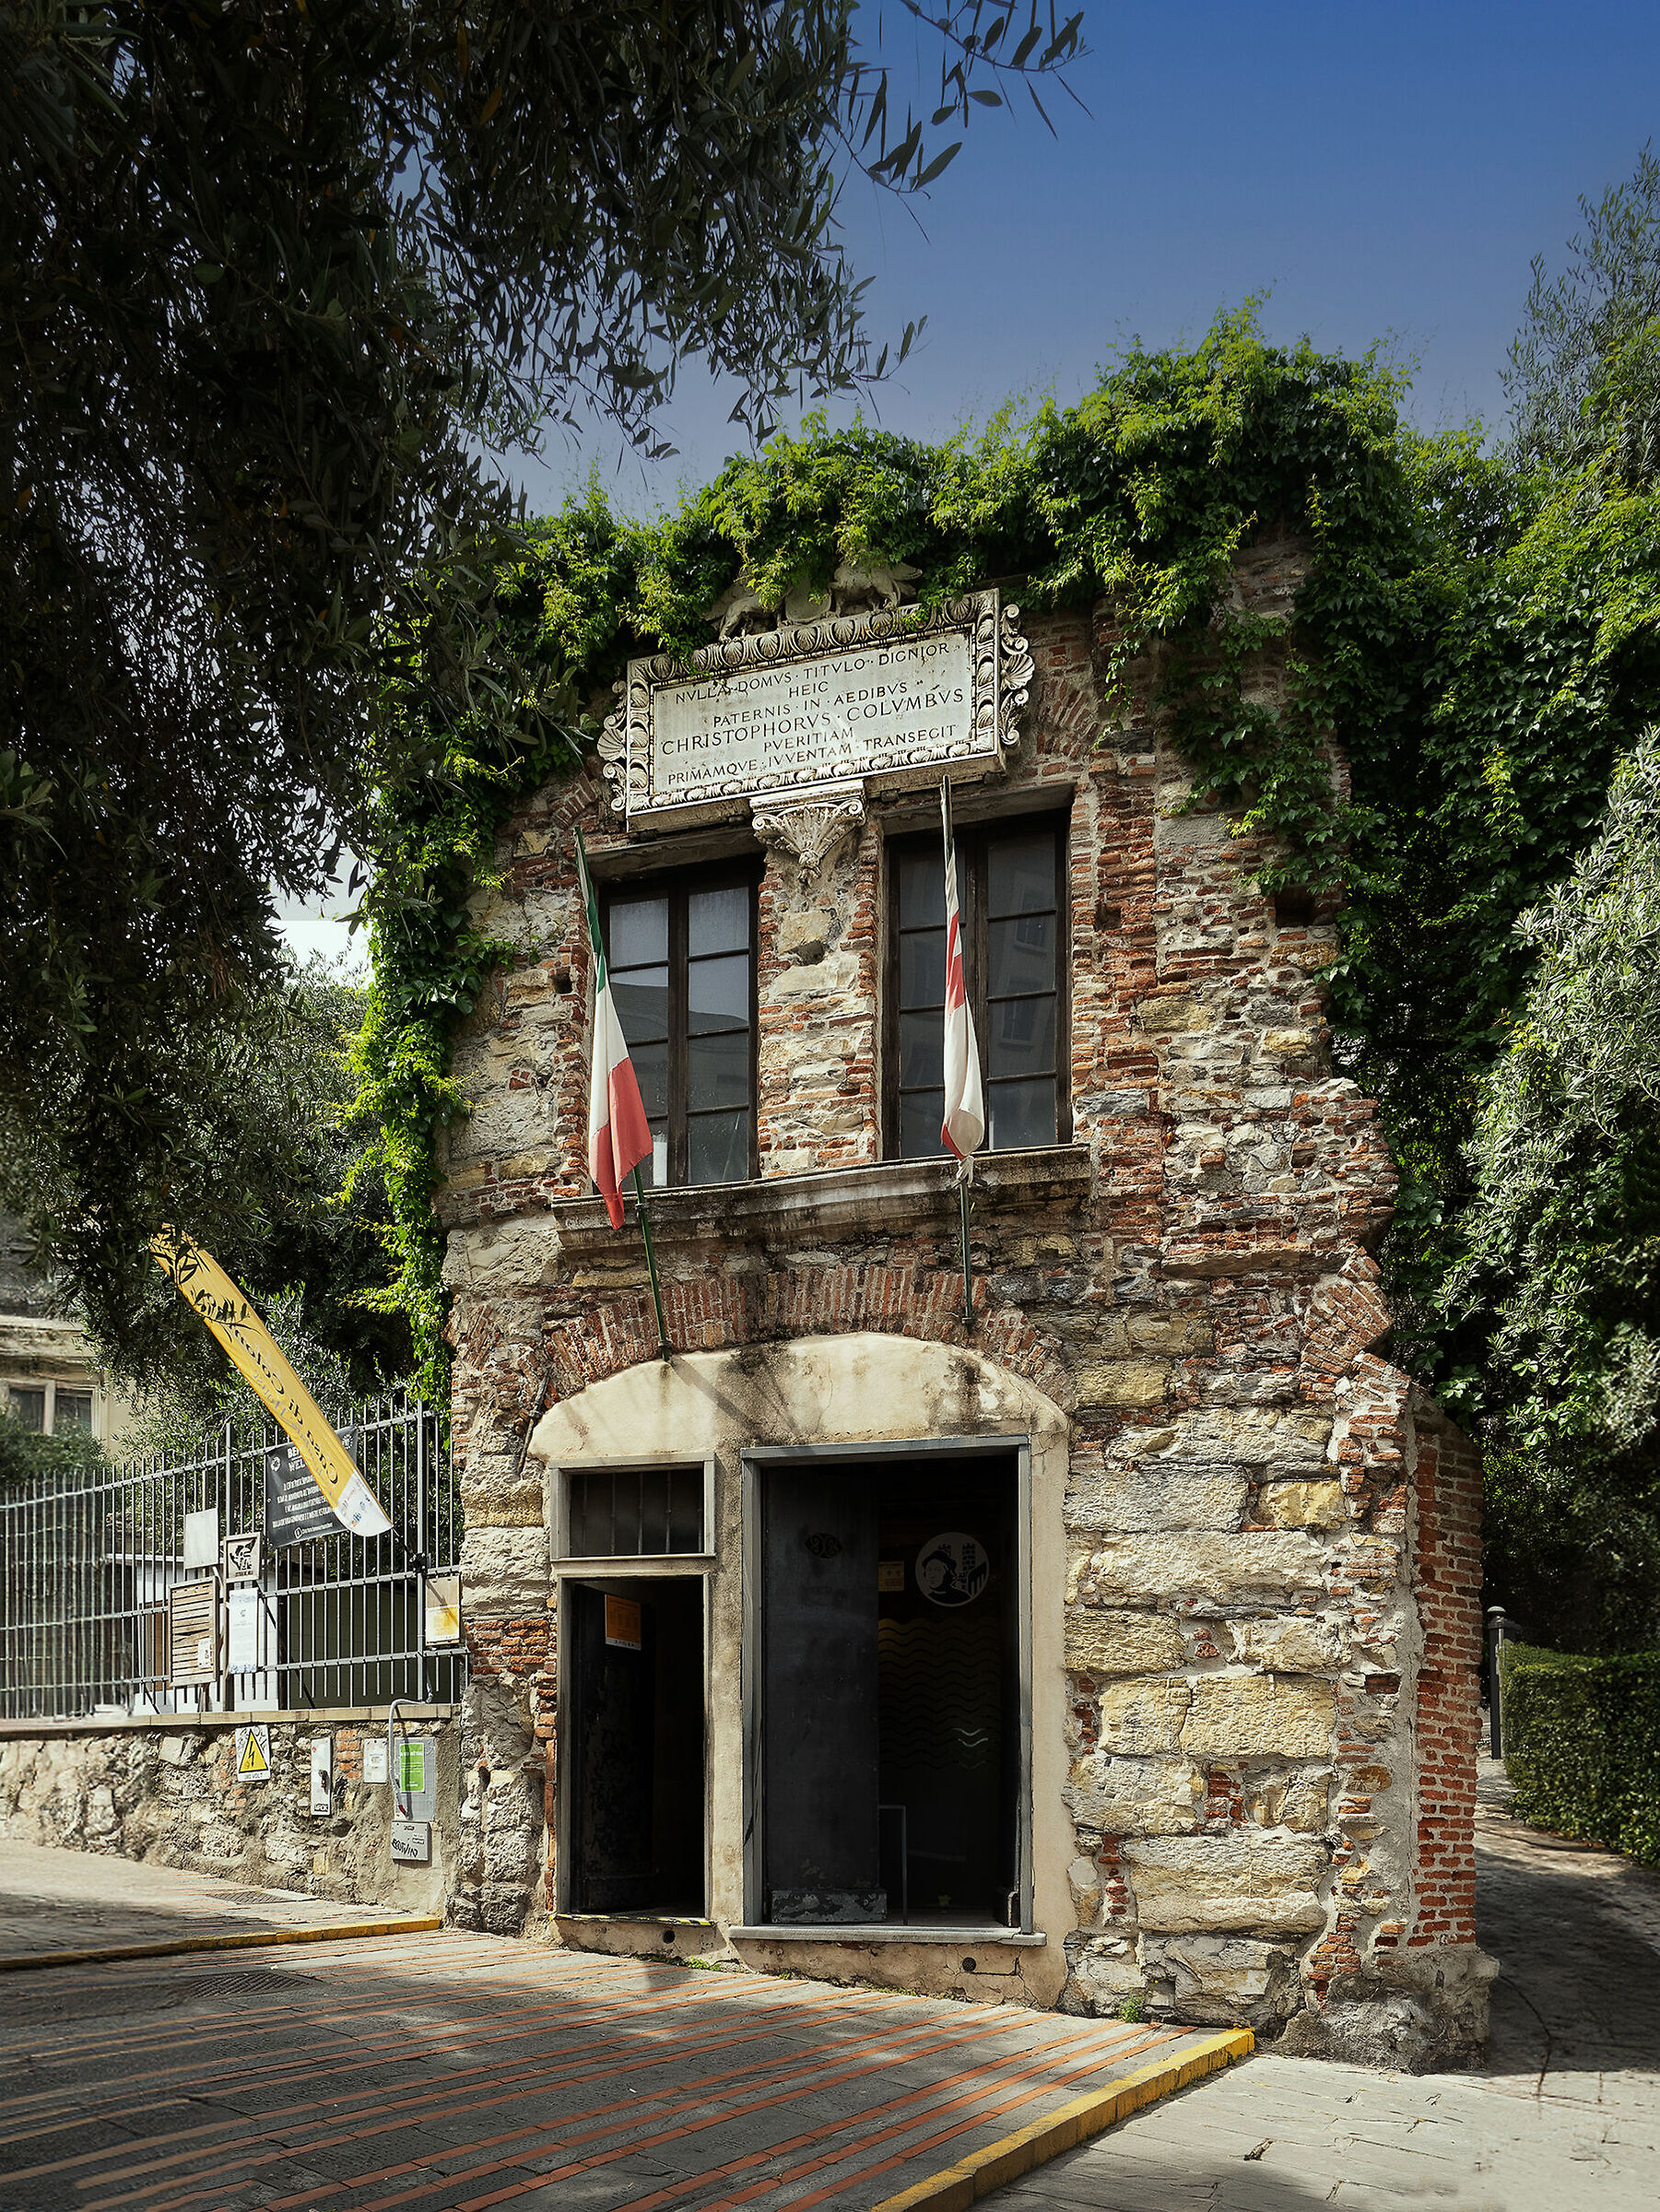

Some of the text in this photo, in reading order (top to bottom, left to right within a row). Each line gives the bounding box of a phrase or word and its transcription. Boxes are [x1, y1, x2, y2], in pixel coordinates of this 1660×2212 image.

[737, 672, 792, 692] DOMVS
[803, 658, 865, 679] TITVLO
[878, 642, 949, 666] DIGNIOR
[789, 681, 829, 699] HEIC
[662, 688, 963, 756] CHRISTOPHORVS COLVMBVS
[713, 682, 908, 728] PATERNIS IN AEDIBVS
[668, 724, 957, 784] PRIMAMQVE IVVENTAM TRANSEGIT
[764, 727, 854, 752] PVERITIAM
